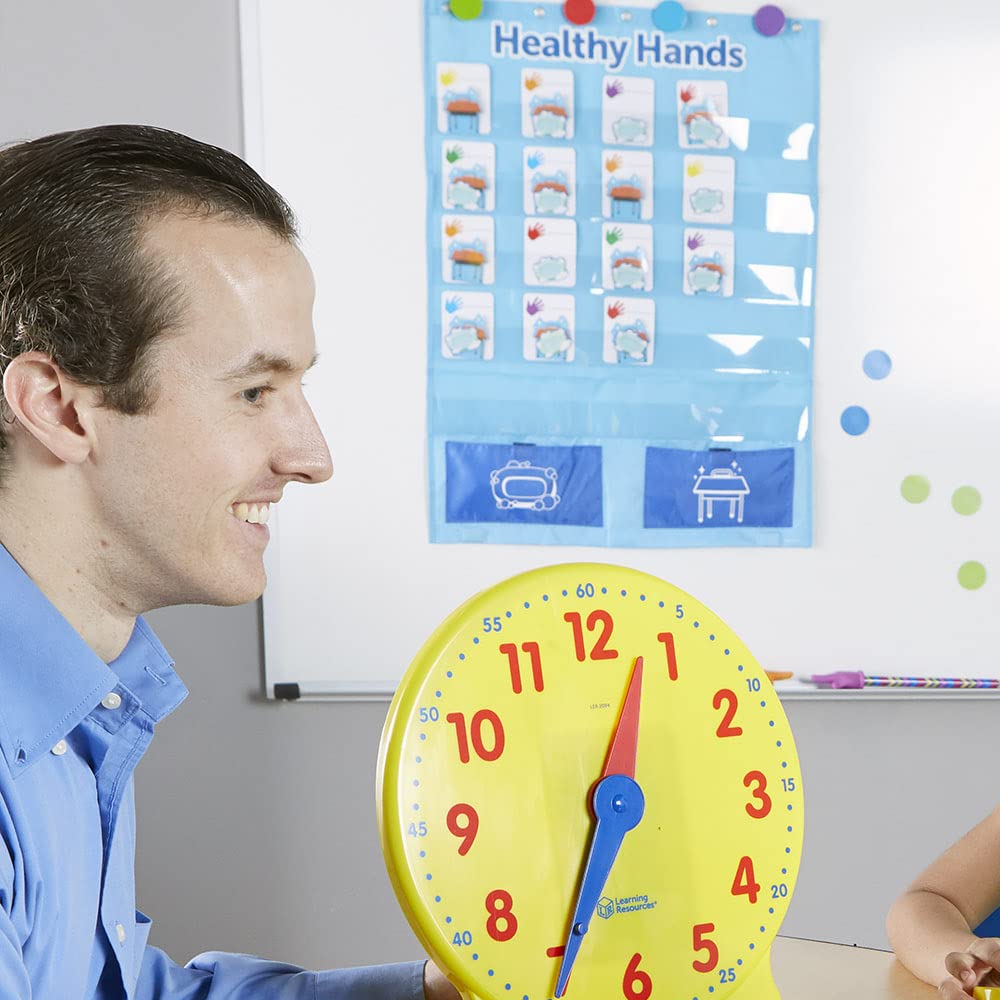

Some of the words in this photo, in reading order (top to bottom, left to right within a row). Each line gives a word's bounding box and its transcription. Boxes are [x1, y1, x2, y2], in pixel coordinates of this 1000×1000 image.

[494, 25, 628, 69] Healthy
[637, 33, 743, 68] Hands
[576, 583, 595, 598] 60
[676, 605, 684, 619] 5
[483, 617, 502, 633] 55
[564, 609, 619, 662] 12
[657, 632, 678, 681] 1
[499, 641, 545, 694] 11
[747, 678, 761, 692] 10
[419, 706, 439, 723] 50
[712, 688, 743, 738] 2
[445, 709, 505, 764] 10
[783, 778, 795, 791] 15
[743, 770, 772, 819] 3
[408, 821, 427, 837] 45
[445, 803, 479, 856] 9
[731, 855, 761, 904] 4
[615, 894, 649, 905] Learning
[771, 883, 787, 899] 20
[485, 889, 518, 942] 8
[616, 902, 657, 914] Resources
[452, 930, 473, 946] 40
[692, 923, 719, 973] 5
[719, 967, 736, 984] 25
